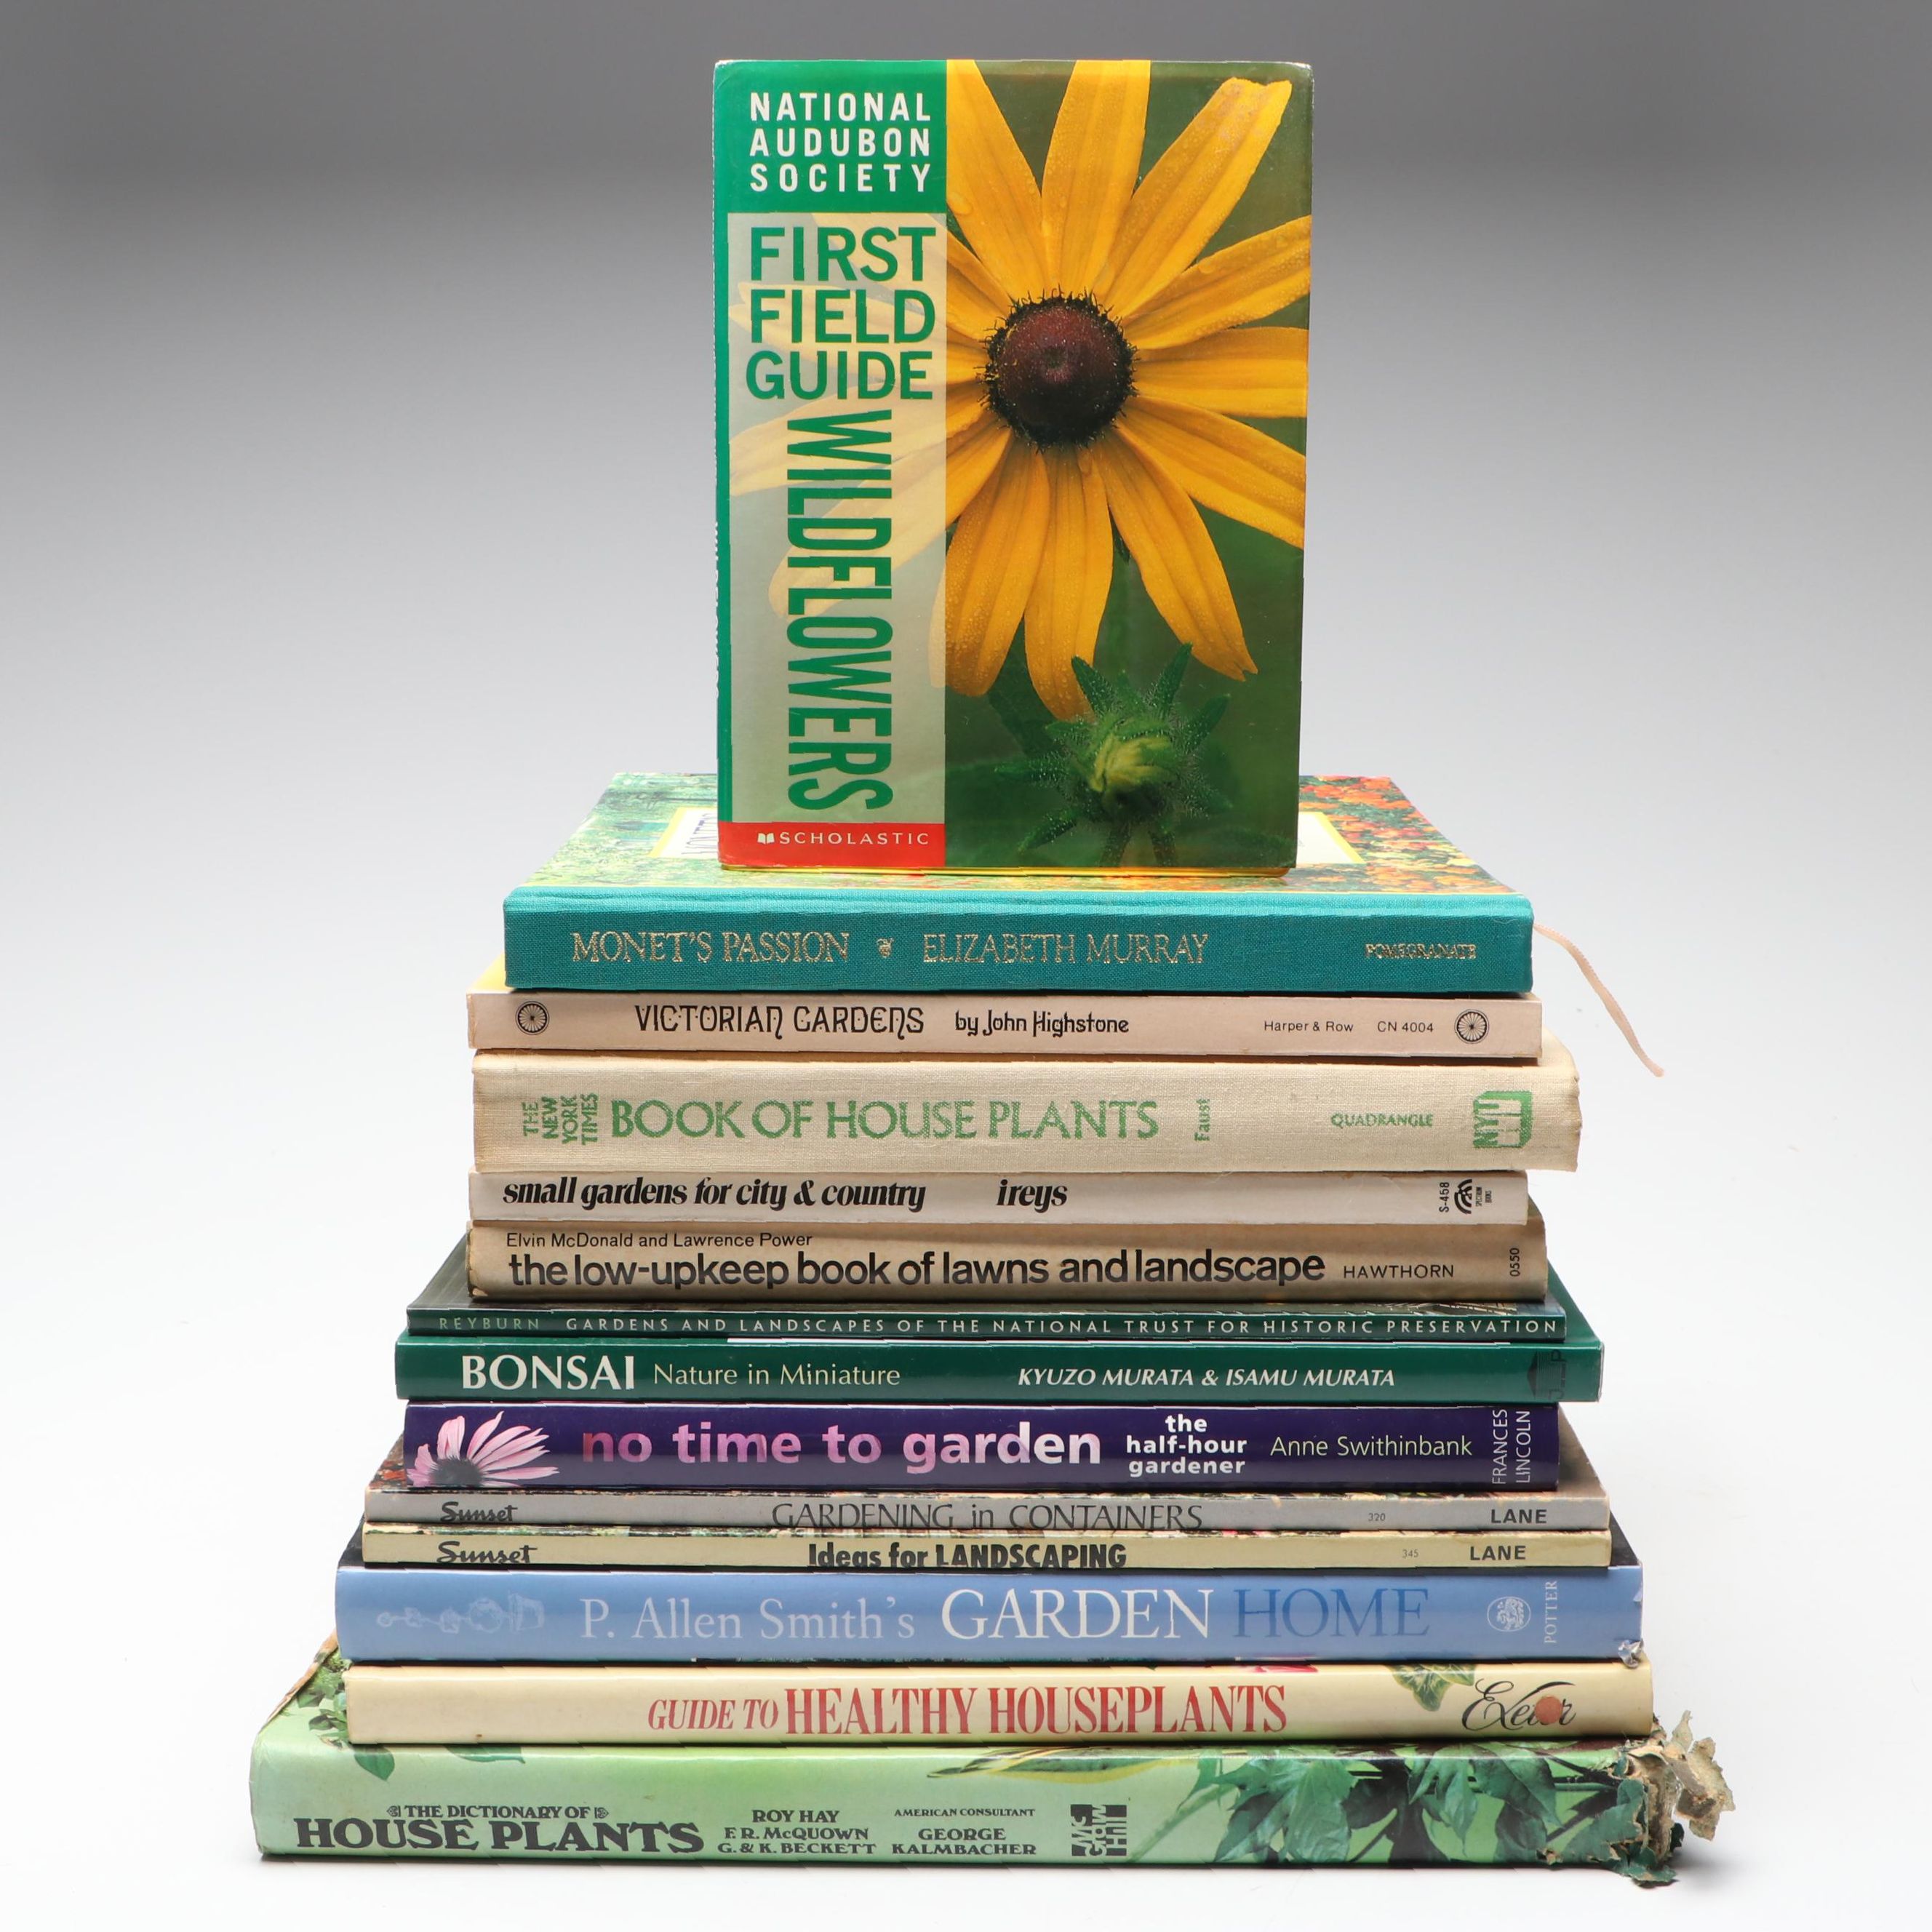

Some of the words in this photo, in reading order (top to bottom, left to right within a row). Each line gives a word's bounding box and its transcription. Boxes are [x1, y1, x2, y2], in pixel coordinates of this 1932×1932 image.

[751, 92, 931, 121] NATIONAL
[750, 128, 930, 157] AUDUBON
[751, 163, 930, 193] SOCIETY
[751, 227, 936, 282] FIRST
[751, 289, 935, 343] FIELD
[746, 351, 933, 400] GUIDE
[787, 409, 893, 810] WILDFLOWERS
[780, 831, 929, 845] SCHOLASTIC
[572, 931, 712, 964] MONET'S
[722, 932, 849, 963] PASSION
[923, 933, 1074, 965] ELIZABETH
[1086, 933, 1208, 965] MURRAY
[1365, 943, 1477, 959] POMEGRANATE
[635, 1004, 783, 1040] VICTORIAN
[794, 1005, 925, 1041] GARDENS
[955, 1010, 978, 1037] by
[983, 1008, 1027, 1037] John
[1033, 1010, 1130, 1038] Highstone
[1264, 1020, 1309, 1034] Harper
[1313, 1021, 1322, 1032] &
[1326, 1021, 1354, 1033] Row
[1377, 1021, 1398, 1033] CN
[1402, 1021, 1434, 1034] 4004
[522, 1101, 539, 1137] THE
[541, 1096, 559, 1139] NEW
[561, 1094, 579, 1144] YORK
[582, 1093, 599, 1146] TIMES
[611, 1099, 746, 1138] BOOK
[751, 1100, 814, 1138] OF
[827, 1100, 976, 1139] HOUSE
[988, 1100, 1159, 1140] PLANTS
[1194, 1098, 1211, 1141] Faust
[1330, 1113, 1434, 1129] QUADRANGLE
[503, 1177, 578, 1205] small
[580, 1178, 687, 1210] gardens
[693, 1177, 732, 1205] for
[737, 1179, 787, 1211] city
[794, 1179, 816, 1206] &
[821, 1181, 926, 1213] country
[996, 1179, 1067, 1213] ireys
[507, 1232, 546, 1248] Elvin
[551, 1232, 633, 1248] McDonald
[639, 1233, 668, 1248] and
[674, 1233, 754, 1248] Lawrence
[760, 1233, 813, 1248] Power
[508, 1253, 568, 1286] the
[575, 1253, 789, 1289] low-upkeep
[798, 1251, 890, 1285] book
[898, 1251, 935, 1285] of
[943, 1251, 1049, 1285] lawns
[1059, 1249, 1128, 1283] and
[1135, 1248, 1325, 1286] landscape
[1344, 1264, 1454, 1278] HAWTHORN
[1509, 1248, 1520, 1277] 0550
[439, 1317, 539, 1330] REYBURN
[566, 1317, 668, 1331] GARDENS
[682, 1318, 726, 1331] AND
[739, 1319, 883, 1333] LANDSCAPES
[897, 1320, 925, 1333] OF
[938, 1320, 979, 1333] THE
[993, 1320, 1111, 1333] NATIONAL
[1124, 1320, 1194, 1333] TRUST
[1208, 1320, 1249, 1334] FOR
[1264, 1320, 1373, 1334] HISTORIC
[1386, 1320, 1557, 1334] PRESERVATION
[462, 1354, 634, 1390] BONSAI
[654, 1364, 738, 1385] Nature
[749, 1365, 770, 1385] in
[781, 1364, 901, 1386] Miniature
[1018, 1368, 1096, 1387] KYUZO
[1102, 1368, 1194, 1386] MURATA
[1202, 1370, 1219, 1386] &
[1226, 1369, 1298, 1386] ISAMU
[1303, 1369, 1395, 1386] MURATA
[1165, 1414, 1207, 1433] the
[583, 1431, 652, 1464] no
[672, 1421, 802, 1464] time
[822, 1424, 882, 1464] to
[903, 1421, 1101, 1474] garden
[1126, 1435, 1247, 1454] half-hour
[1271, 1437, 1328, 1456] Anne
[1338, 1436, 1472, 1456] Swithinbank
[1492, 1408, 1508, 1485] FRANCES
[1516, 1410, 1530, 1484] LINCOLN
[1129, 1458, 1245, 1477] gardener
[440, 1501, 518, 1522] Sunset
[773, 1503, 954, 1528] GARDENING
[972, 1504, 994, 1528] in
[1010, 1504, 1202, 1528] CONTAINERS
[1368, 1512, 1386, 1521] 320
[1491, 1509, 1547, 1524] LANE
[437, 1541, 538, 1564] Sunset
[809, 1542, 881, 1568] Ideas
[889, 1542, 928, 1568] for
[936, 1544, 1127, 1568] LANDSCAPING
[1402, 1549, 1418, 1558] 345
[1470, 1546, 1526, 1561] LANE
[580, 1598, 615, 1639] P.
[631, 1597, 743, 1639] Allen
[760, 1596, 915, 1640] Smith's
[942, 1589, 1214, 1640] GARDEN
[1233, 1587, 1430, 1639] HOME
[1544, 1580, 1558, 1644] POTTER
[648, 1699, 736, 1731] GUIDE
[743, 1699, 778, 1730] TO
[785, 1688, 978, 1735] HEALTHY
[987, 1685, 1287, 1734] HOUSEPLANTS
[1461, 1678, 1576, 1731] Exer
[404, 1805, 443, 1818] THE
[447, 1805, 563, 1819] DICTIONARY
[564, 1806, 591, 1819] OF
[752, 1810, 795, 1824] ROY
[799, 1810, 840, 1824] HAY
[895, 1808, 957, 1817] AMERICAN
[959, 1808, 1036, 1816] CONSULTANT
[293, 1819, 479, 1851] HOUSE
[489, 1821, 705, 1853] PLANTS
[765, 1827, 869, 1840] McQUOWN
[918, 1827, 1006, 1841] GEORGE
[740, 1843, 754, 1853] &
[759, 1843, 777, 1854] K.
[781, 1843, 877, 1854] BECKETT
[892, 1843, 1037, 1856] KALMBACHER
